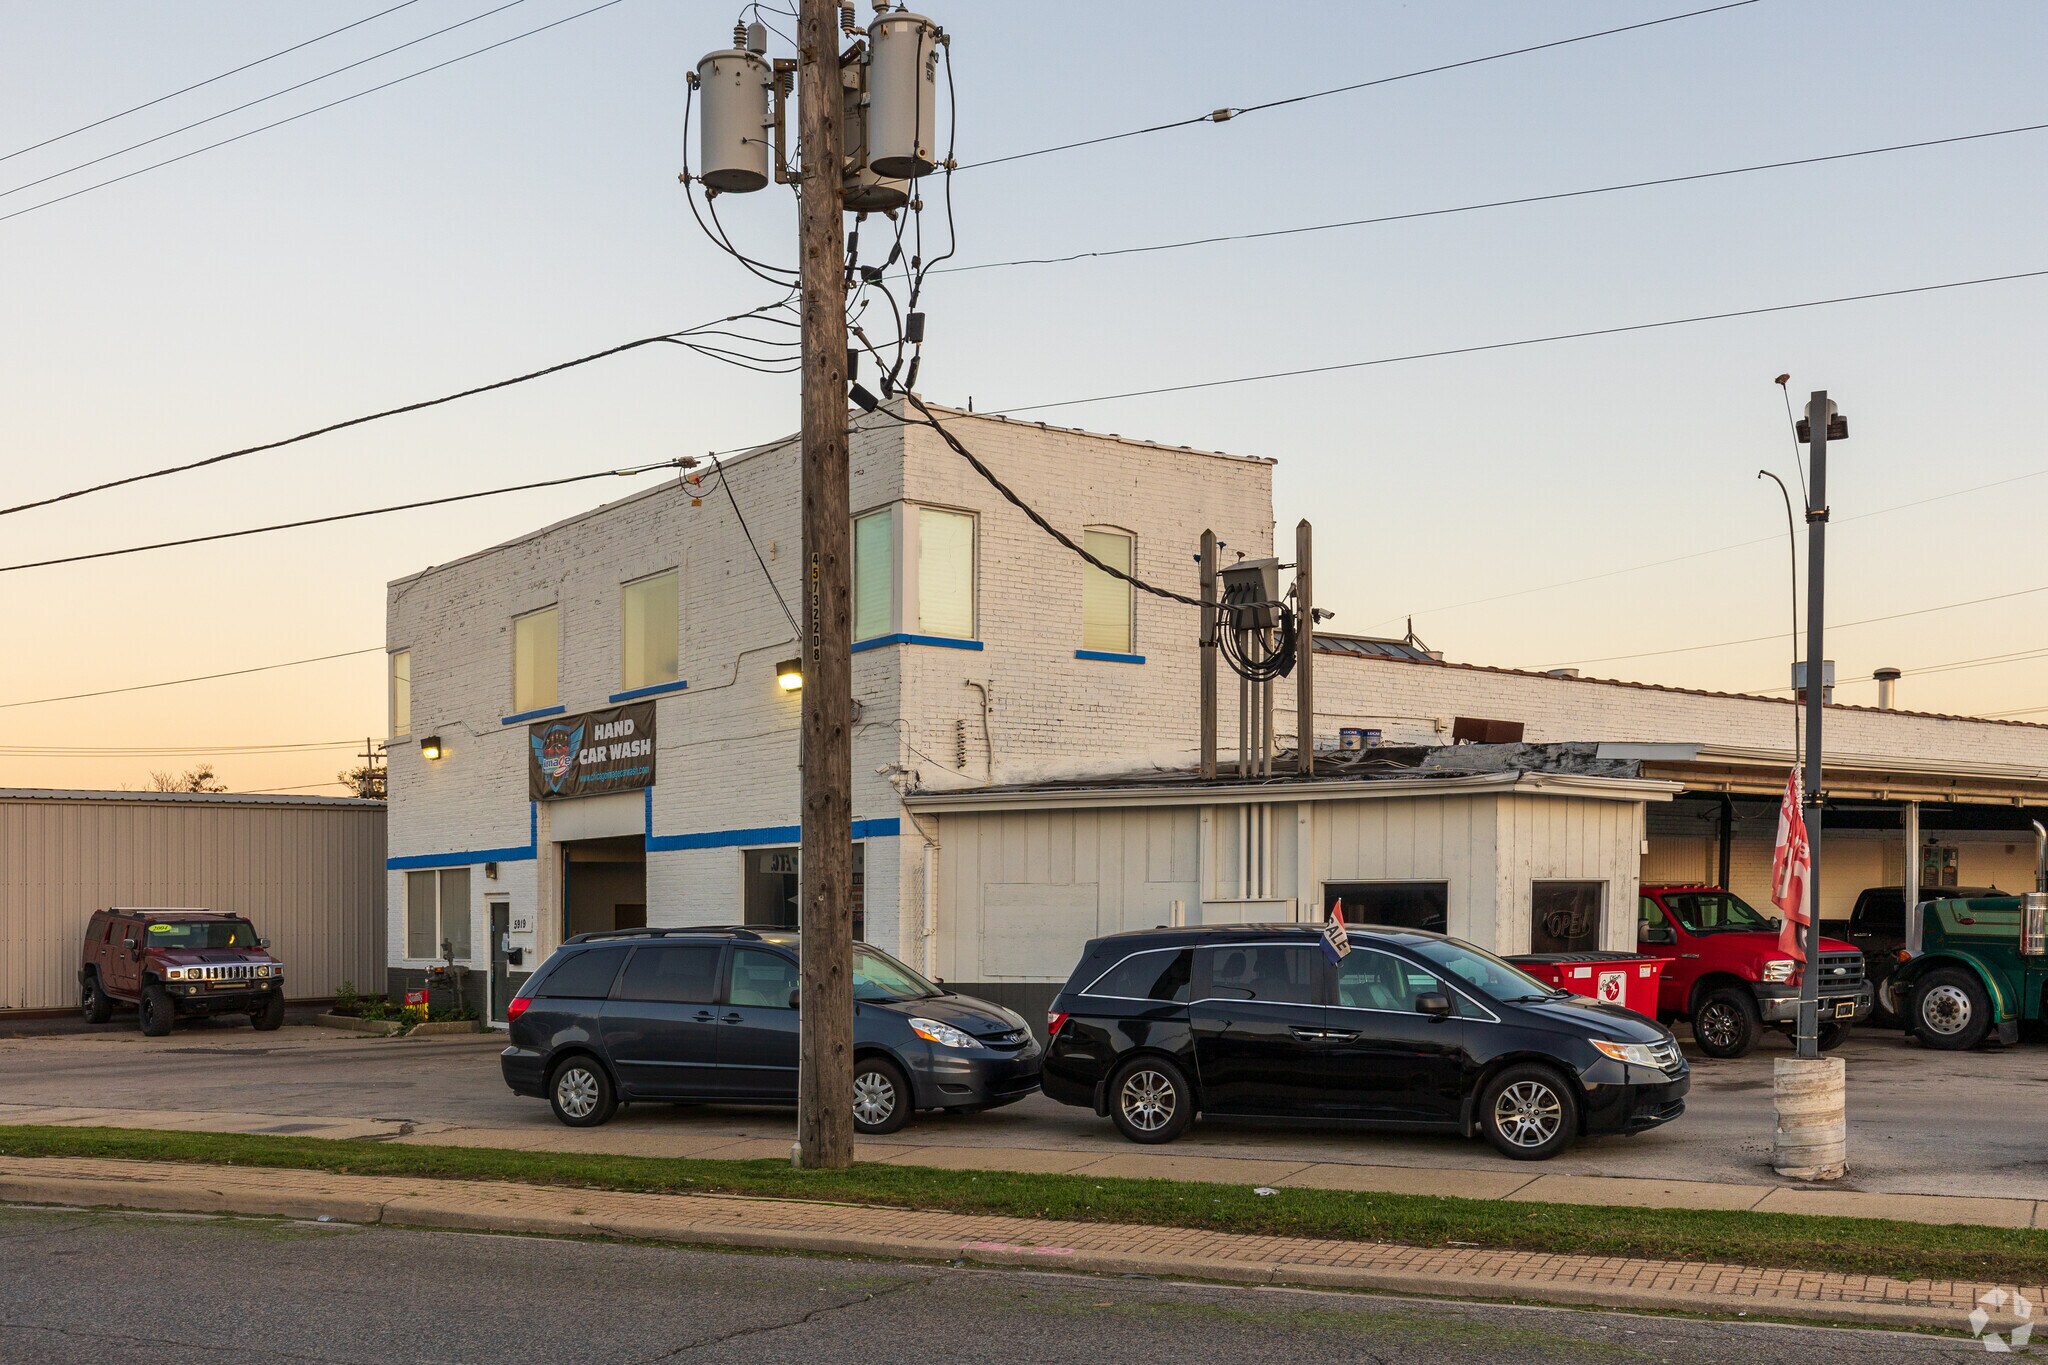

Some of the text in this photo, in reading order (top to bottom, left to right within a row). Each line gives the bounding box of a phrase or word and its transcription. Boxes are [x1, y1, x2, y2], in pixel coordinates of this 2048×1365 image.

[812, 553, 820, 660] 45732208
[594, 718, 635, 741] HAND
[579, 738, 651, 765] CAR WASH
[513, 918, 527, 930] 5919
[1326, 917, 1348, 951] SALE
[1551, 913, 1587, 937] OPEN
